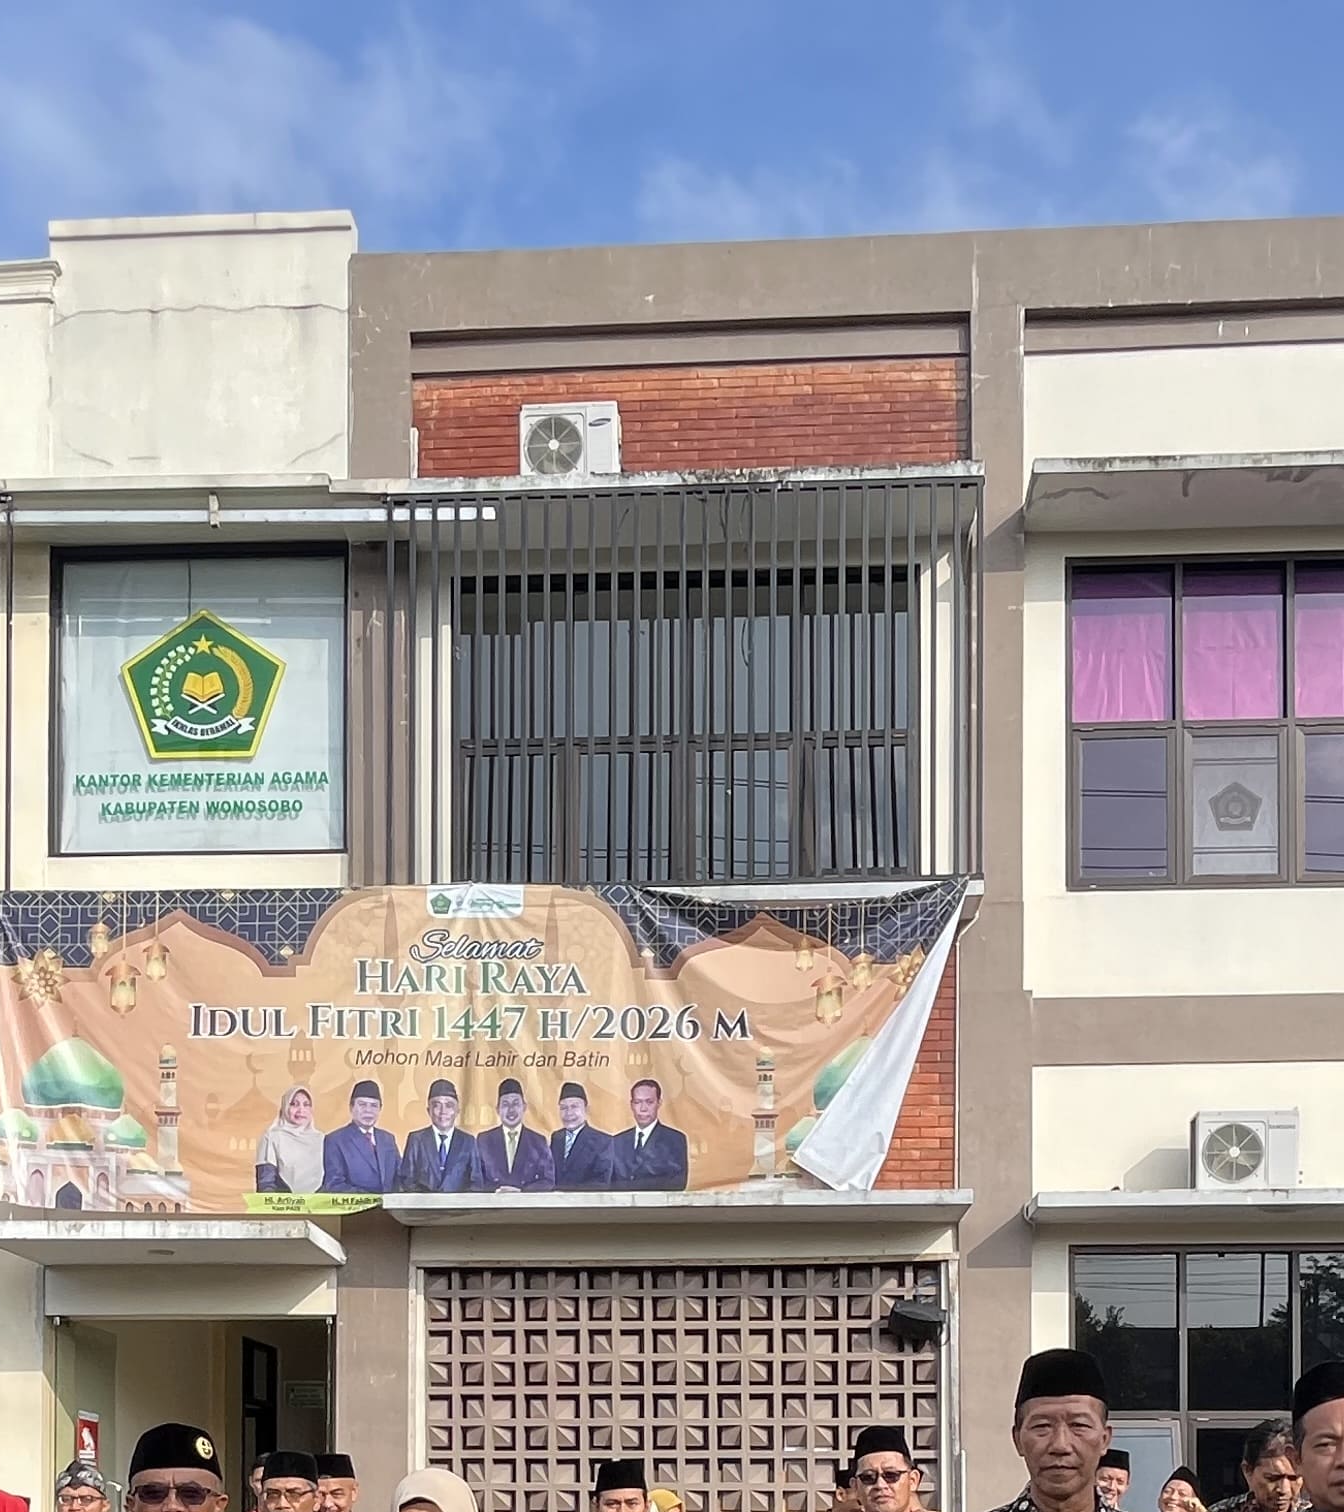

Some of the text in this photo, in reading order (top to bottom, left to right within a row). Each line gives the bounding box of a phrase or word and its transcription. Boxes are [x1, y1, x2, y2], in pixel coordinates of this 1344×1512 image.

[75, 770, 330, 788] KANTOR KEMENTERIAN AGAMA
[101, 799, 303, 816] KABUPATEN WONOSOBO
[409, 929, 545, 963] Selamat
[355, 958, 589, 995] HARI RAYA
[190, 1003, 753, 1041] IDUL FITRI 1447 H/2026 M
[355, 1049, 610, 1068] Mohon Maaf Lahir dan Batin
